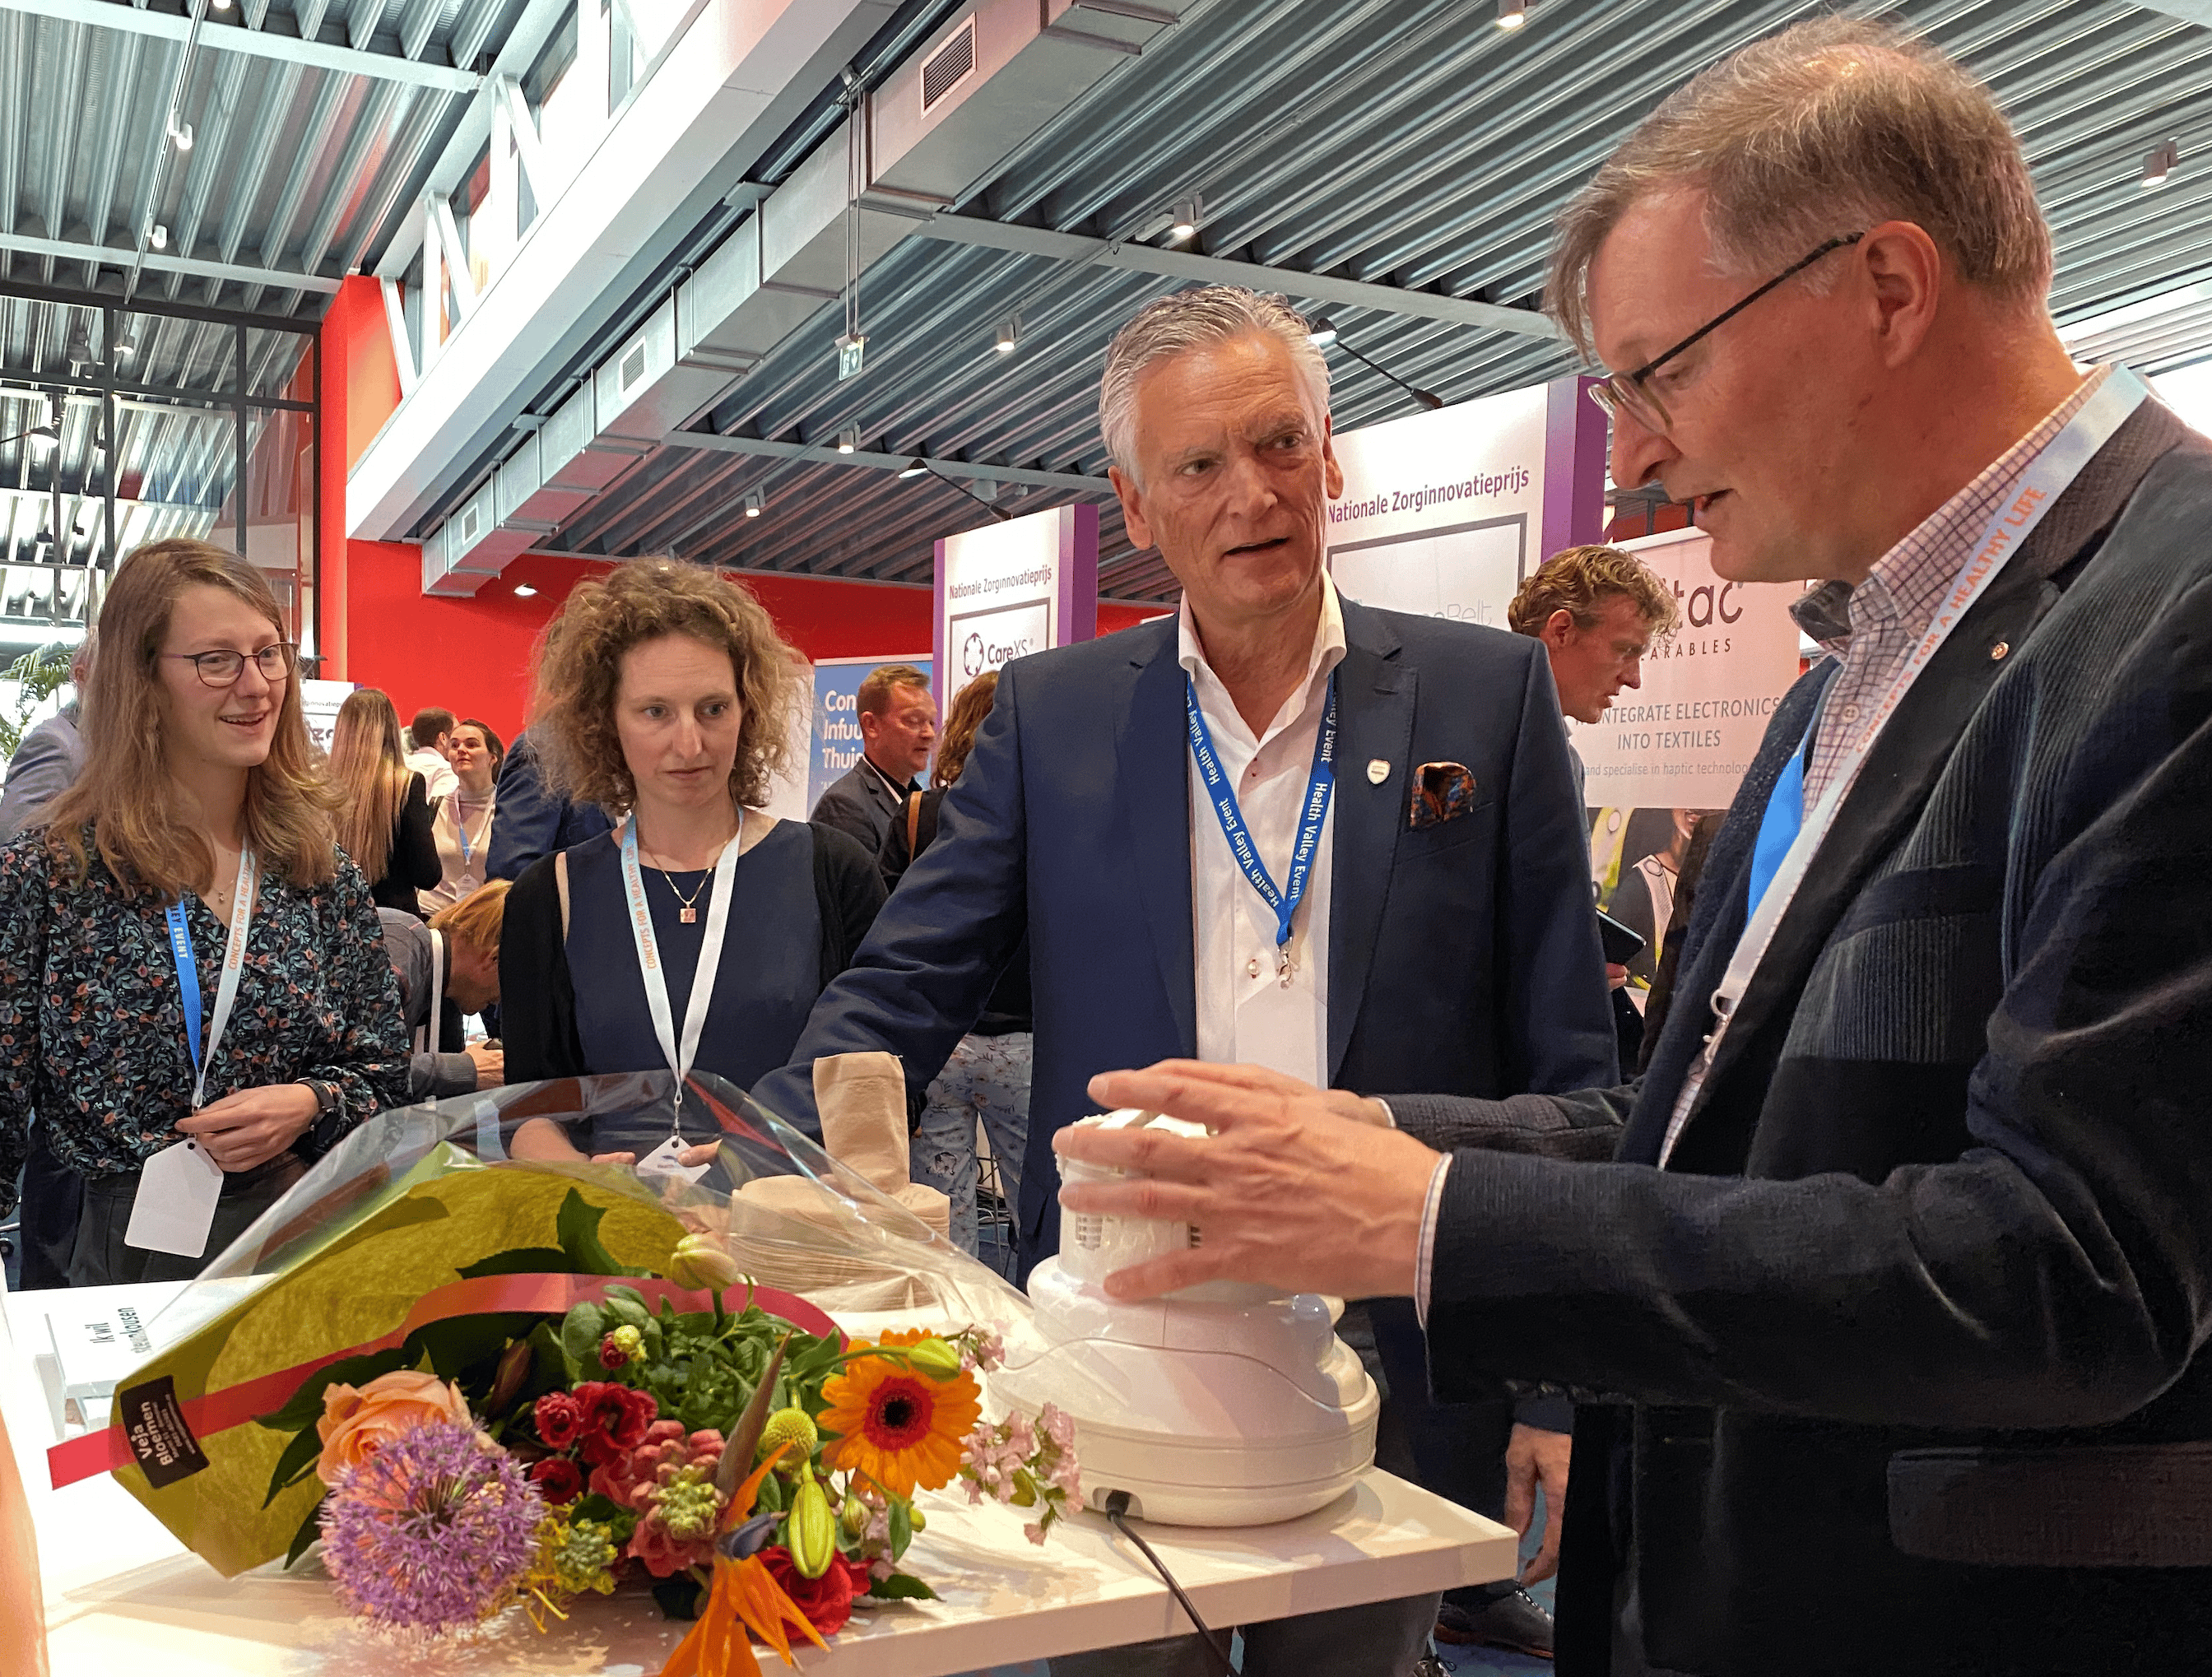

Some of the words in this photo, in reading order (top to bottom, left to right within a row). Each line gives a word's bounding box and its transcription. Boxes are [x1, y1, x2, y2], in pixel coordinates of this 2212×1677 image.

[1328, 495, 1388, 524] Nationale
[1392, 466, 1529, 513] Zorginnovatieprijs
[950, 580, 982, 600] Nationale
[983, 564, 1052, 594] Zorginnovatieprijs
[1674, 580, 1743, 629] tac
[1856, 671, 1914, 753] CONCEPTS
[1913, 633, 1940, 666] FOR
[1940, 616, 1952, 629] A
[1949, 528, 2011, 609] HEALTHY
[2004, 485, 2047, 527] LIFE
[988, 639, 1028, 664] CareXS
[1650, 638, 1730, 660] ARABLES
[825, 690, 857, 712] Con
[1601, 704, 1671, 723] NTEGRATE
[825, 718, 863, 740] Infuu
[1188, 709, 1203, 746] Valley
[1618, 733, 1650, 750] INTO
[1656, 730, 1721, 748] TEXTILES
[1321, 729, 1336, 763] Event
[1199, 746, 1220, 785] Health
[1585, 764, 1601, 775] and
[1604, 763, 1648, 778] specialise
[1652, 763, 1660, 774] in
[1663, 761, 1694, 776] haptic
[1219, 797, 1238, 831] Event
[1307, 783, 1327, 821] Health
[1233, 831, 1254, 869] Valley
[1295, 825, 1317, 862] Valley
[240, 862, 249, 897] HEALTH
[628, 865, 642, 899] HEALTHY
[1251, 868, 1280, 907] Health
[1290, 866, 1306, 900] Event
[236, 908, 246, 924] FOR
[635, 909, 648, 926] FOR
[174, 927, 188, 958] EVENT
[228, 927, 244, 970] CONCEPTS
[639, 928, 657, 969] CONCEPTS
[85, 1322, 112, 1335] wil
[90, 1335, 115, 1343] Ik
[130, 1424, 153, 1460] Veja
[141, 1401, 174, 1466] Bloemen
